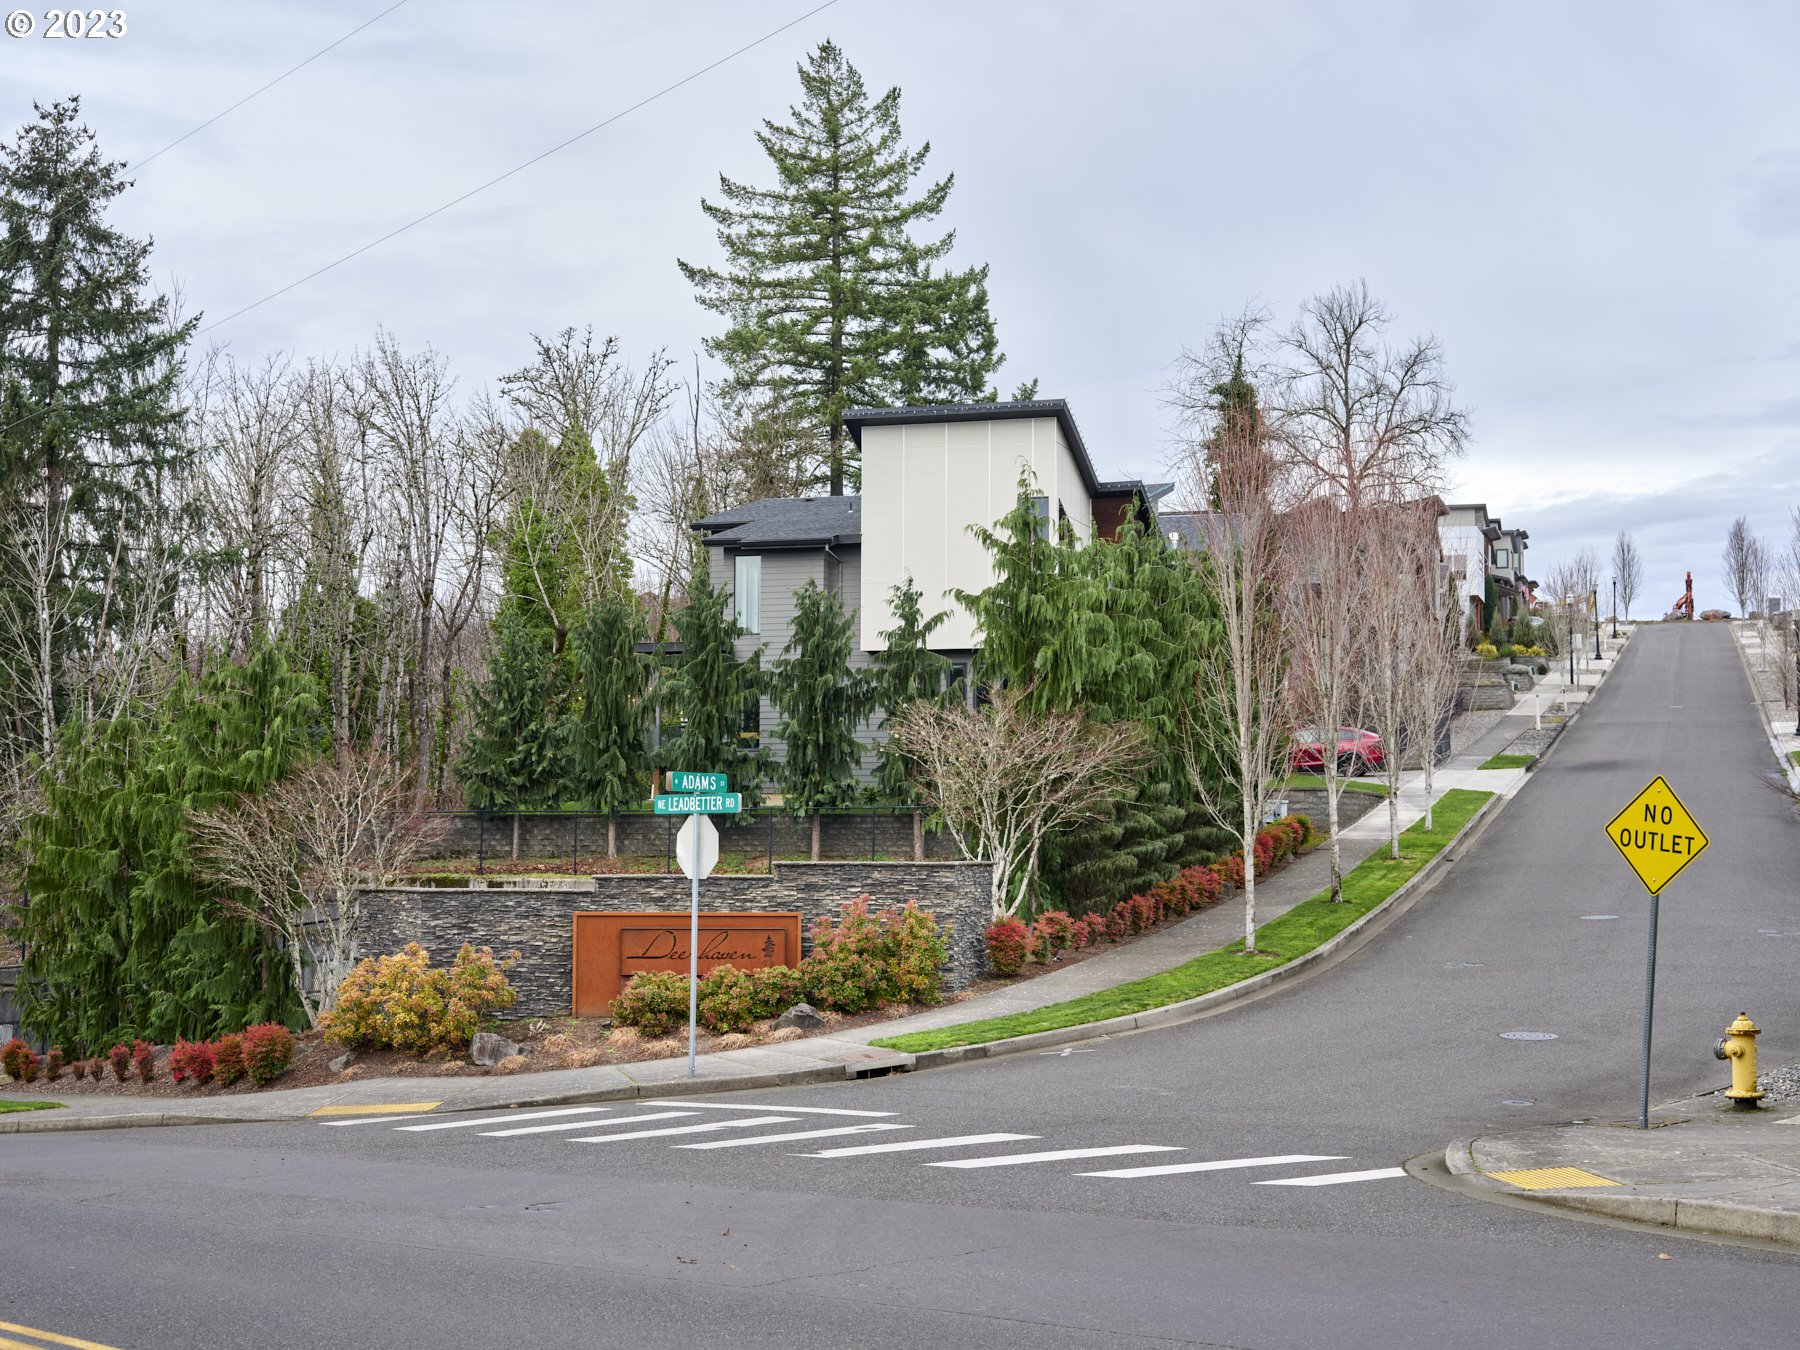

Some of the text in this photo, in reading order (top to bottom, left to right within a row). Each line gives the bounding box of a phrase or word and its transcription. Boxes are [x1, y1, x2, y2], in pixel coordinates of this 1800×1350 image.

[681, 774, 717, 790] ADAMS
[657, 796, 735, 811] NE LEADBETTER RD
[1644, 803, 1673, 825] NO
[1620, 828, 1695, 856] OUTLET
